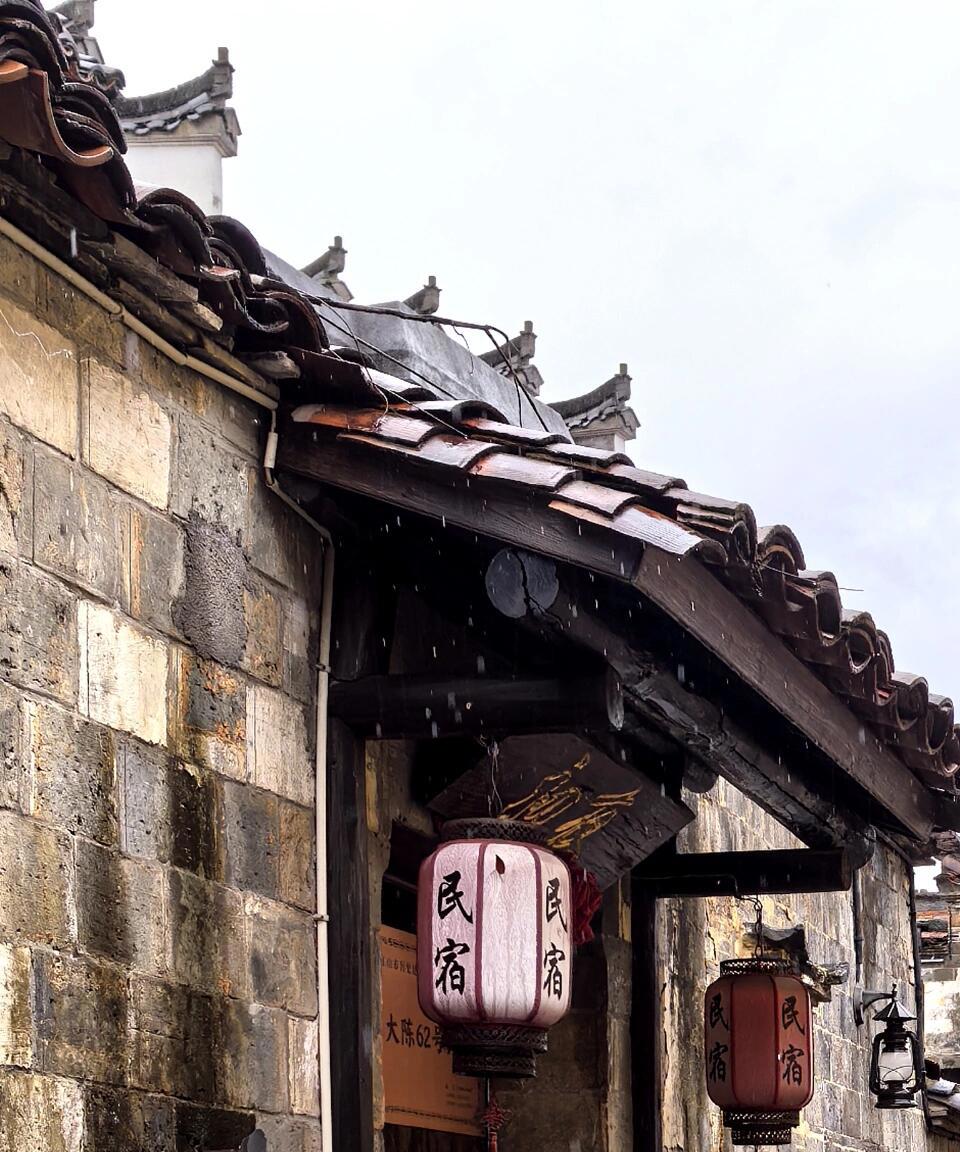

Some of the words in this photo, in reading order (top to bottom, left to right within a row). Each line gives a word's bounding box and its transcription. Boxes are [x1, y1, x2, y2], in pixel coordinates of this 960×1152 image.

[434, 870, 474, 996] 民宿
[543, 877, 569, 1001] 民宿
[708, 992, 730, 1084] 民宿
[781, 995, 805, 1086] 民宿
